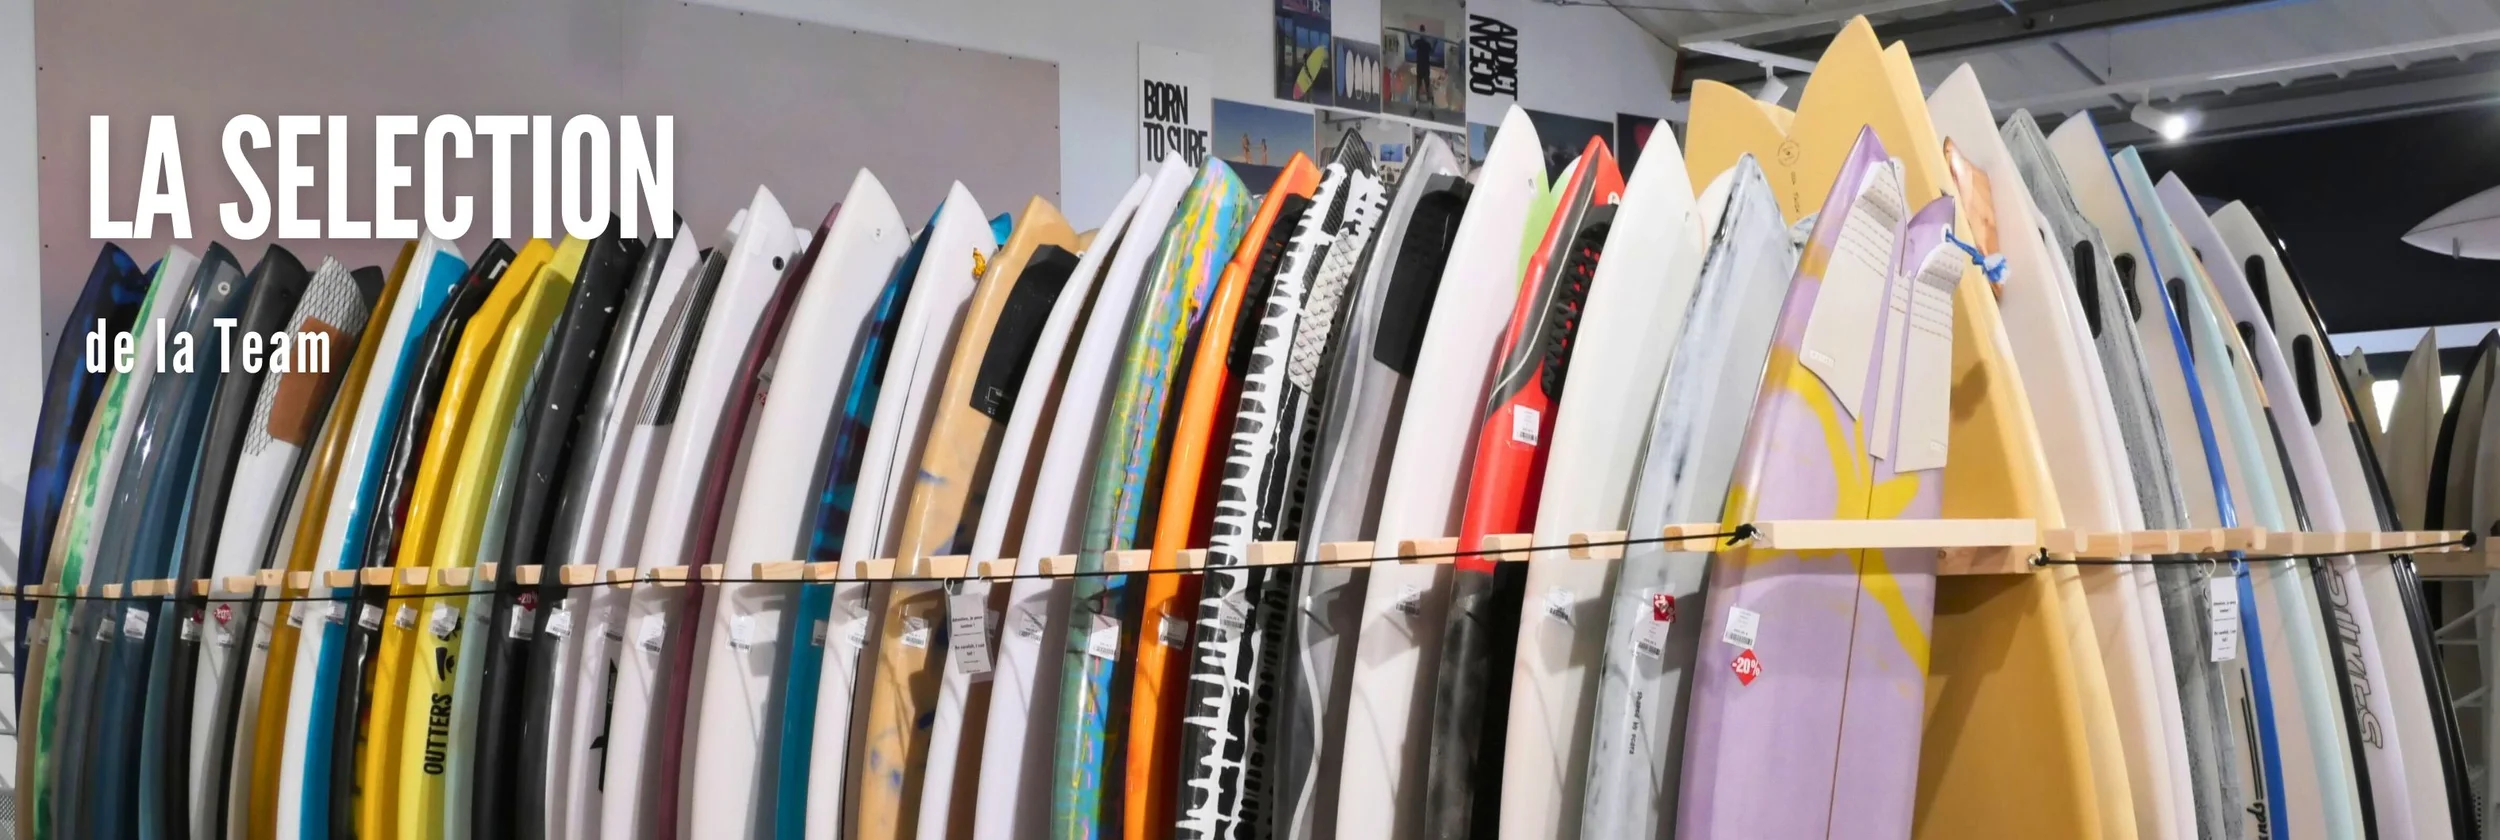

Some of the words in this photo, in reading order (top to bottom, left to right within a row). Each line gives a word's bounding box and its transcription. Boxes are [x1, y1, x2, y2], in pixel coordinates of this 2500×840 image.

[1469, 13, 1496, 96] OCEAN
[1493, 18, 1518, 101] ADDICT
[1144, 79, 1188, 125] BORN
[1143, 121, 1165, 163] TO
[1166, 125, 1208, 168] SURF
[1732, 657, 1761, 676] -20%
[424, 693, 452, 775] OUTTERS
